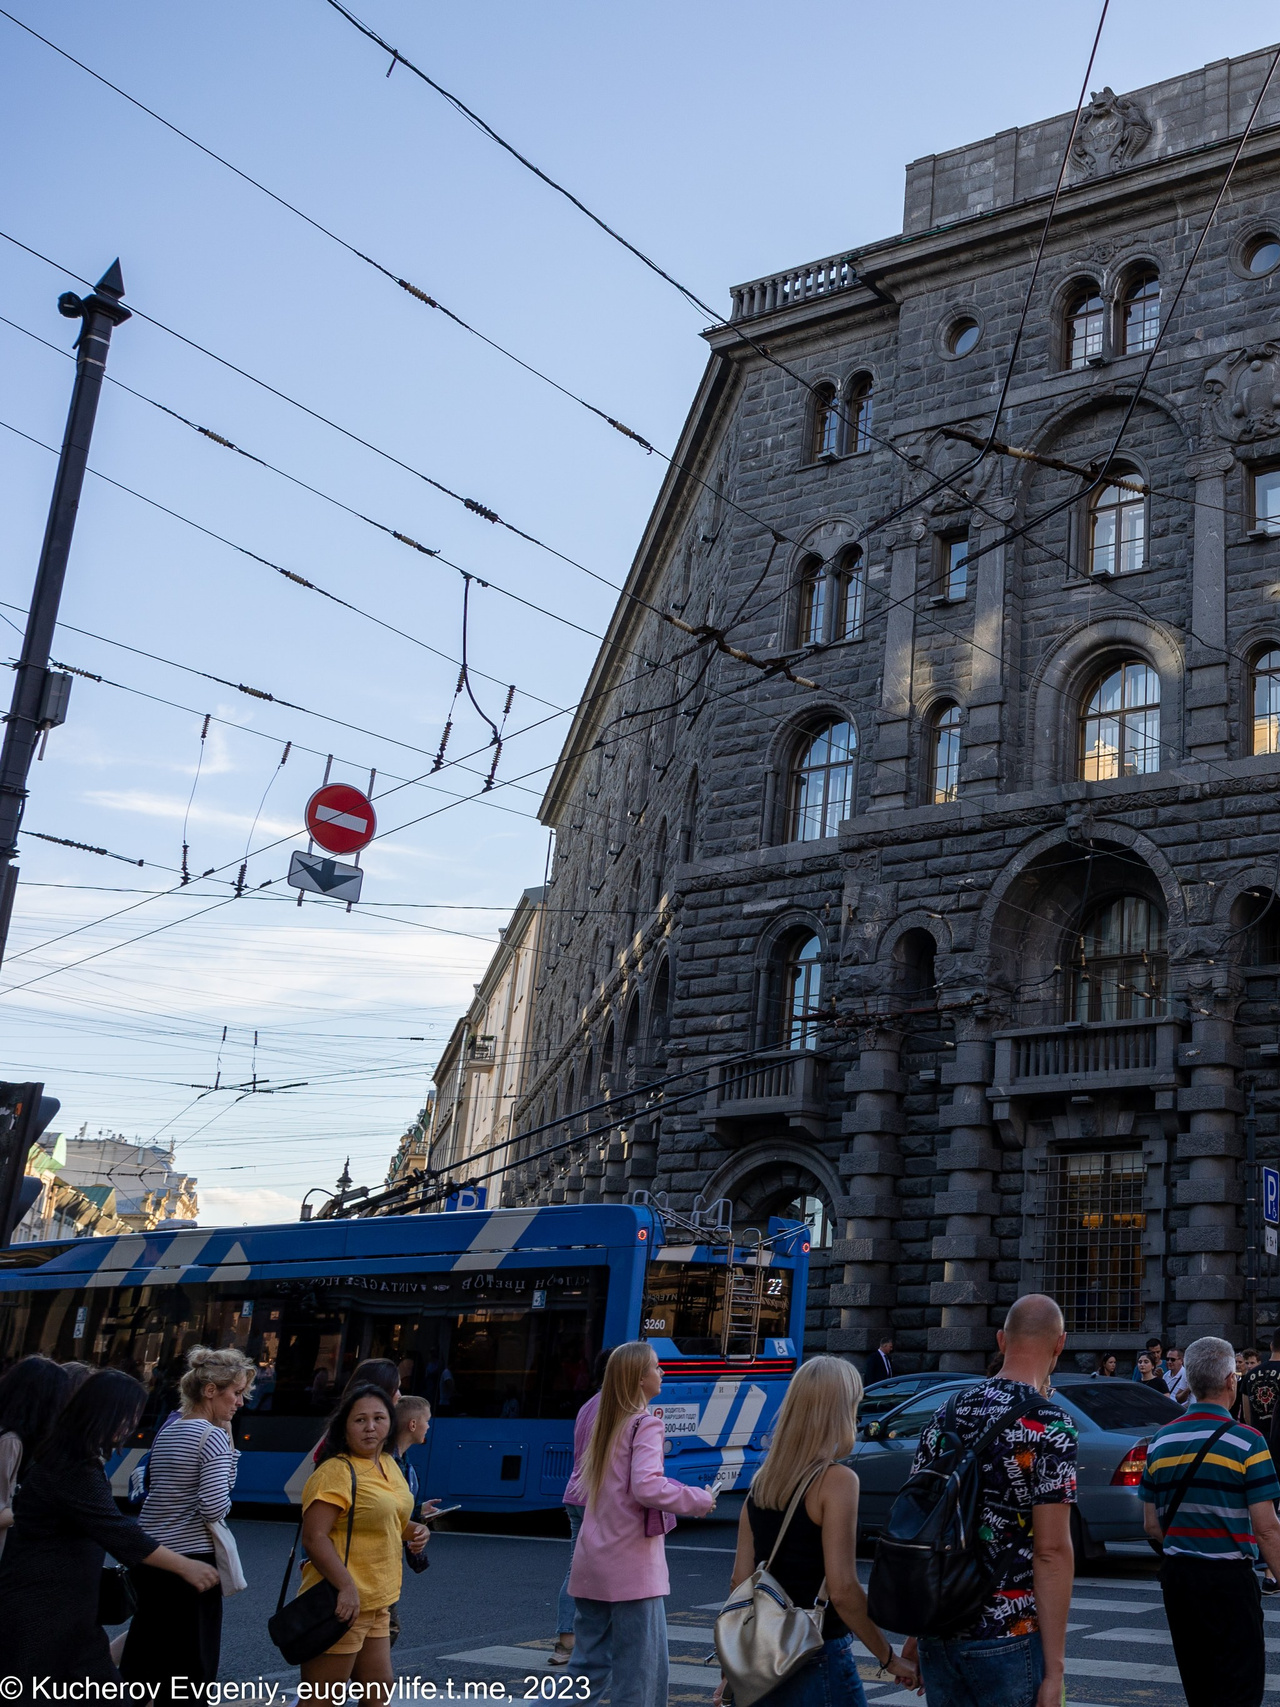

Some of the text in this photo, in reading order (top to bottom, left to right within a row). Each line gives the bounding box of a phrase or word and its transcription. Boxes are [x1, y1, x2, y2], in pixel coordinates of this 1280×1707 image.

[767, 1278, 783, 1295] 22
[643, 1319, 666, 1330] 3260
[671, 1385, 768, 1395] АДМИРАЛ
[980, 1507, 1009, 1529] GAME
